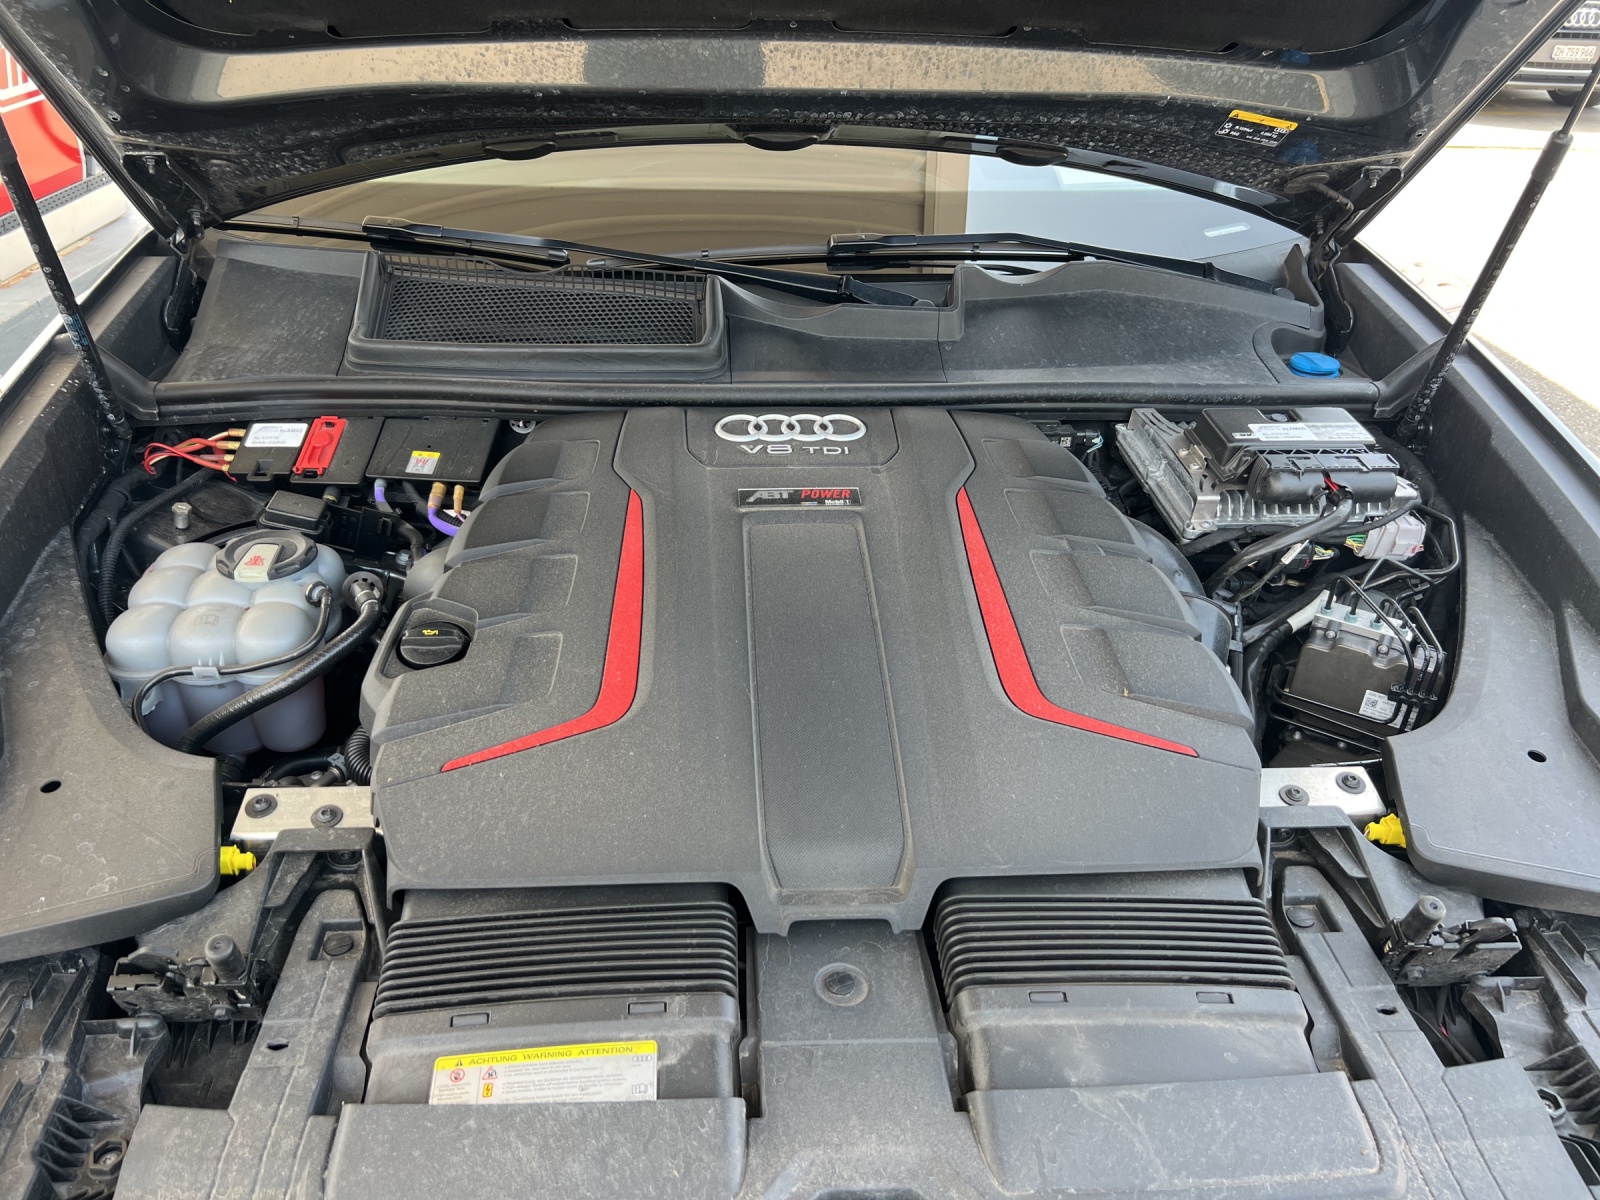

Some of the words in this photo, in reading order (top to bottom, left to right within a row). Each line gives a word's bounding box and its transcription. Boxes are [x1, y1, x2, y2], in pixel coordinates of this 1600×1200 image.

[1554, 47, 1565, 57] ZH
[739, 444, 793, 454] V8
[802, 446, 849, 455] TDI
[746, 490, 795, 503] ABT
[801, 489, 851, 499] POWER
[468, 1054, 517, 1066] ACHTUNG
[522, 1050, 573, 1061] WARNING
[577, 1046, 634, 1057] ATTENTION
